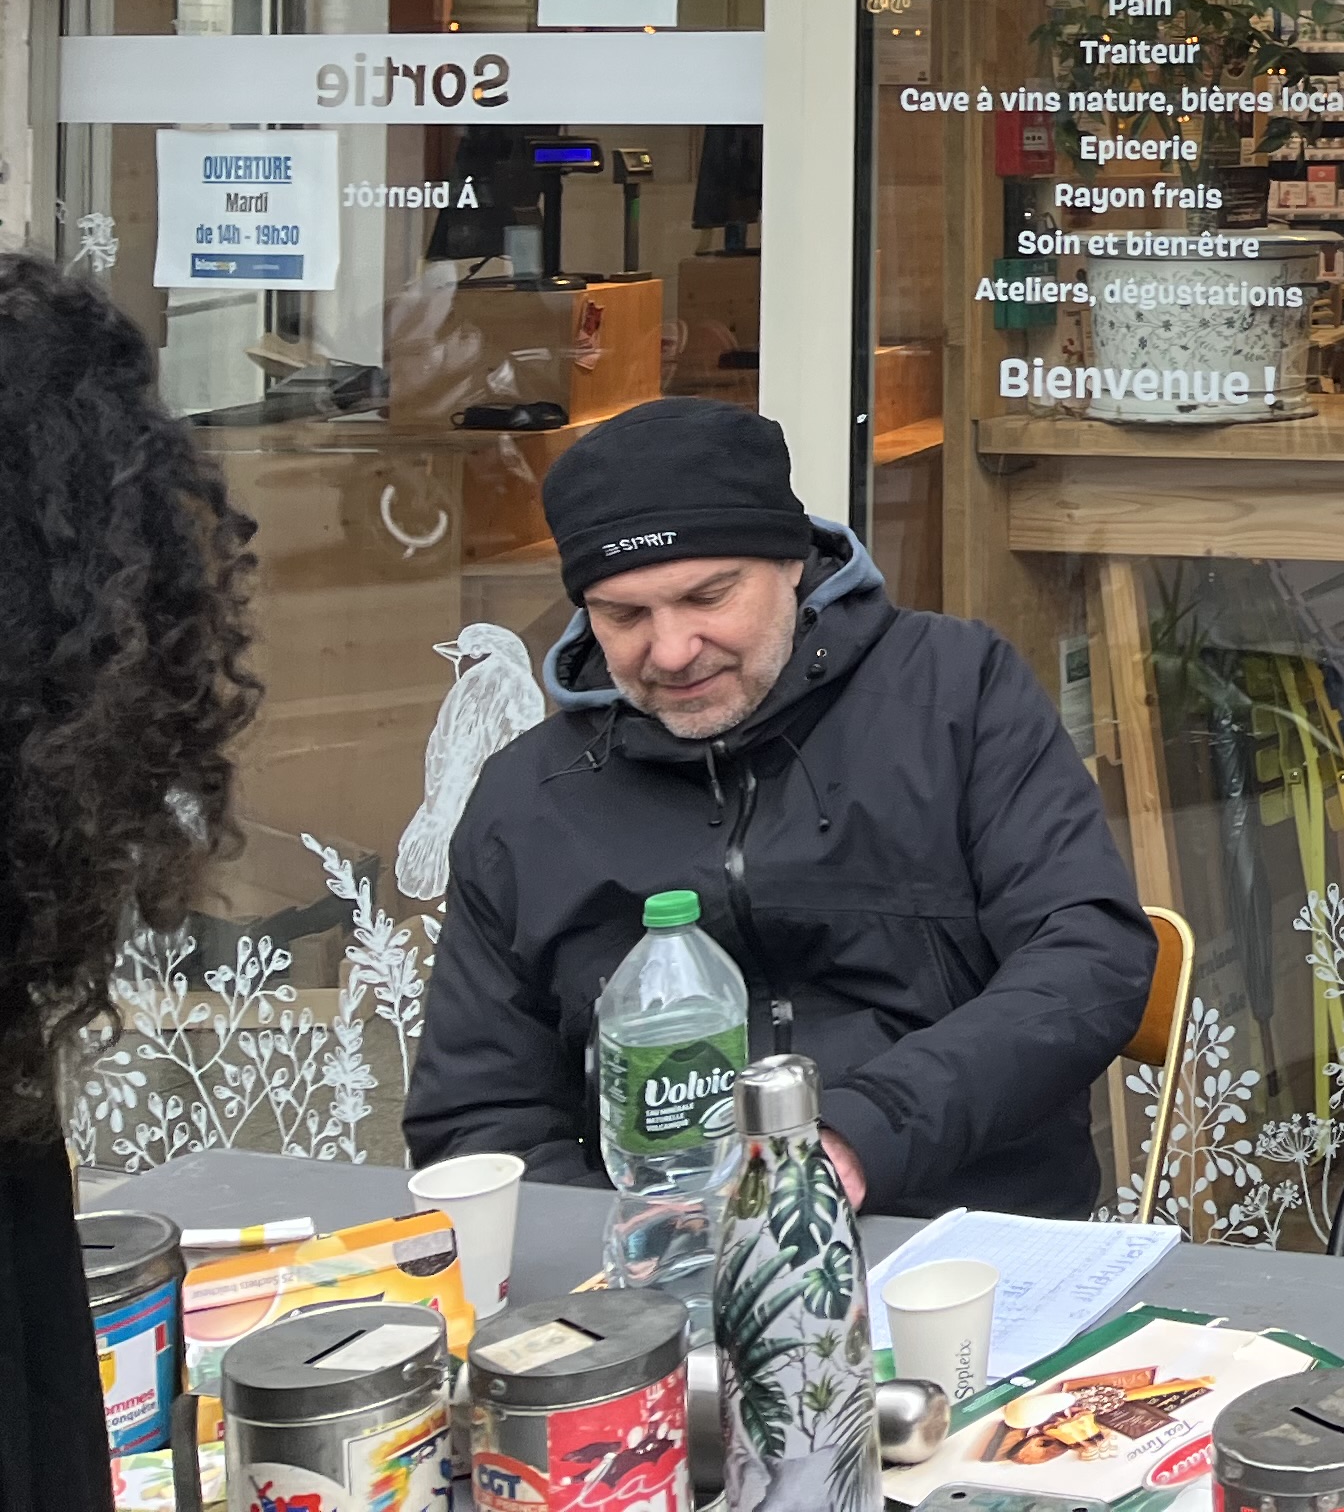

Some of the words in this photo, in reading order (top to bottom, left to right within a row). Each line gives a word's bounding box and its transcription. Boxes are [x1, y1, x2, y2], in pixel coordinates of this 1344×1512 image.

[1079, 39, 1201, 65] Traiteur
[899, 88, 969, 113] Cave
[976, 86, 993, 113] à
[1001, 89, 1061, 113] vins
[1068, 90, 1174, 116] nature,
[1181, 86, 1274, 114] bières
[1079, 135, 1198, 165] Epicerie
[203, 155, 293, 180] OUVERTURE
[226, 191, 269, 214] Mardi
[1054, 183, 1145, 212] Rayon
[1151, 181, 1223, 209] frais
[196, 224, 213, 245] de
[217, 223, 241, 245] 14h
[255, 224, 300, 246] 19h30
[1017, 229, 1081, 256] Soin
[1088, 233, 1119, 257] et
[1125, 230, 1260, 258] bien-être
[974, 277, 1097, 307] Ateliers,
[1104, 279, 1303, 310] dégustations
[999, 358, 1250, 403] Bienvenue
[1262, 367, 1277, 405] !
[601, 531, 678, 557] ESPRIT
[644, 1067, 736, 1107] Volvic
[1163, 1420, 1204, 1439] Tea
[1126, 1436, 1172, 1462] Time
